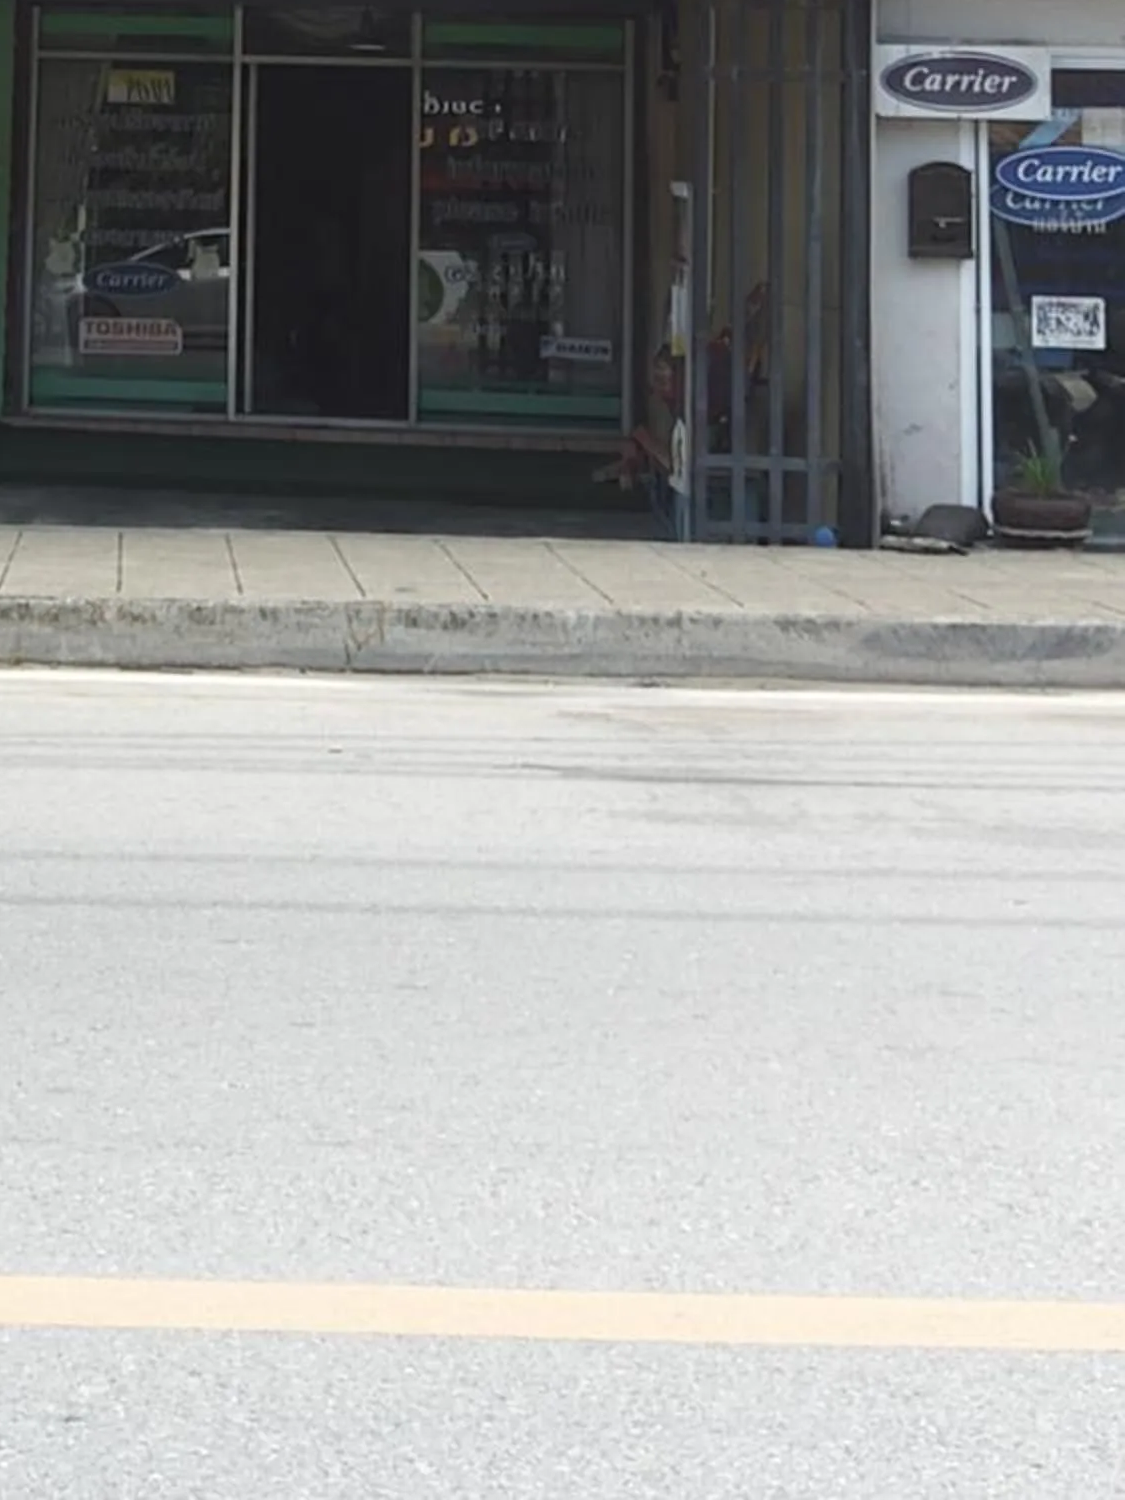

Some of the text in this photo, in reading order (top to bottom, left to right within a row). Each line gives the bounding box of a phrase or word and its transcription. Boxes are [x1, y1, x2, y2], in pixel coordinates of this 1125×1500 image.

[903, 65, 1018, 94] Carrier
[1016, 158, 1123, 184] Carrier
[96, 269, 169, 290] Carrier
[83, 321, 178, 339] TOSHIBA
